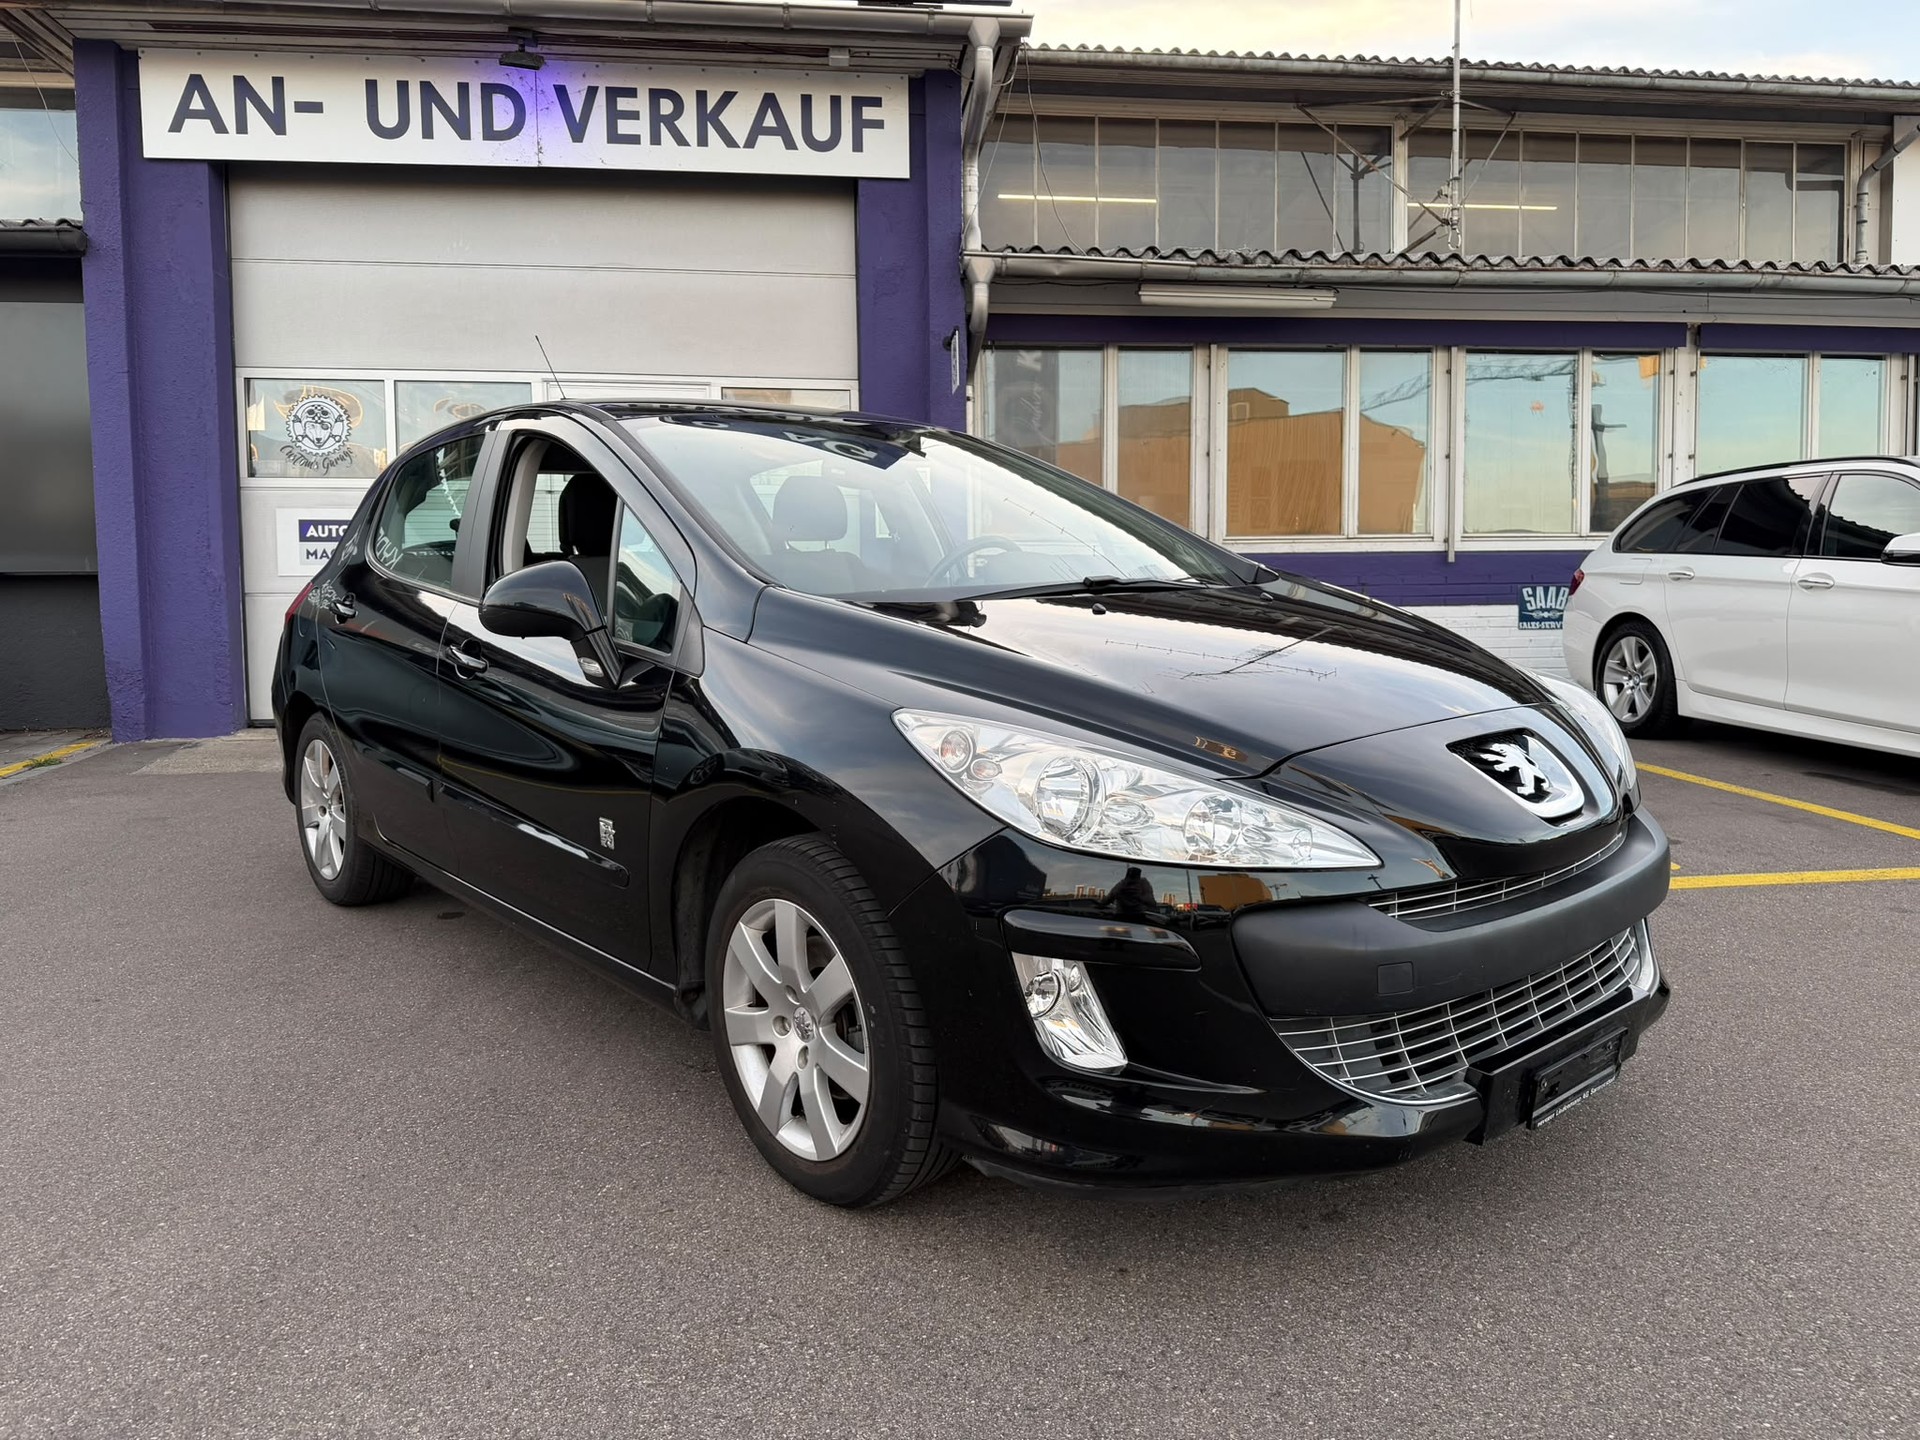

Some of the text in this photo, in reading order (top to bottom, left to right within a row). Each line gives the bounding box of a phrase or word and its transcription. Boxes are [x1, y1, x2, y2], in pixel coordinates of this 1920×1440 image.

[168, 73, 887, 153] AN- UND VERKAUF
[1522, 586, 1569, 610] SAAB
